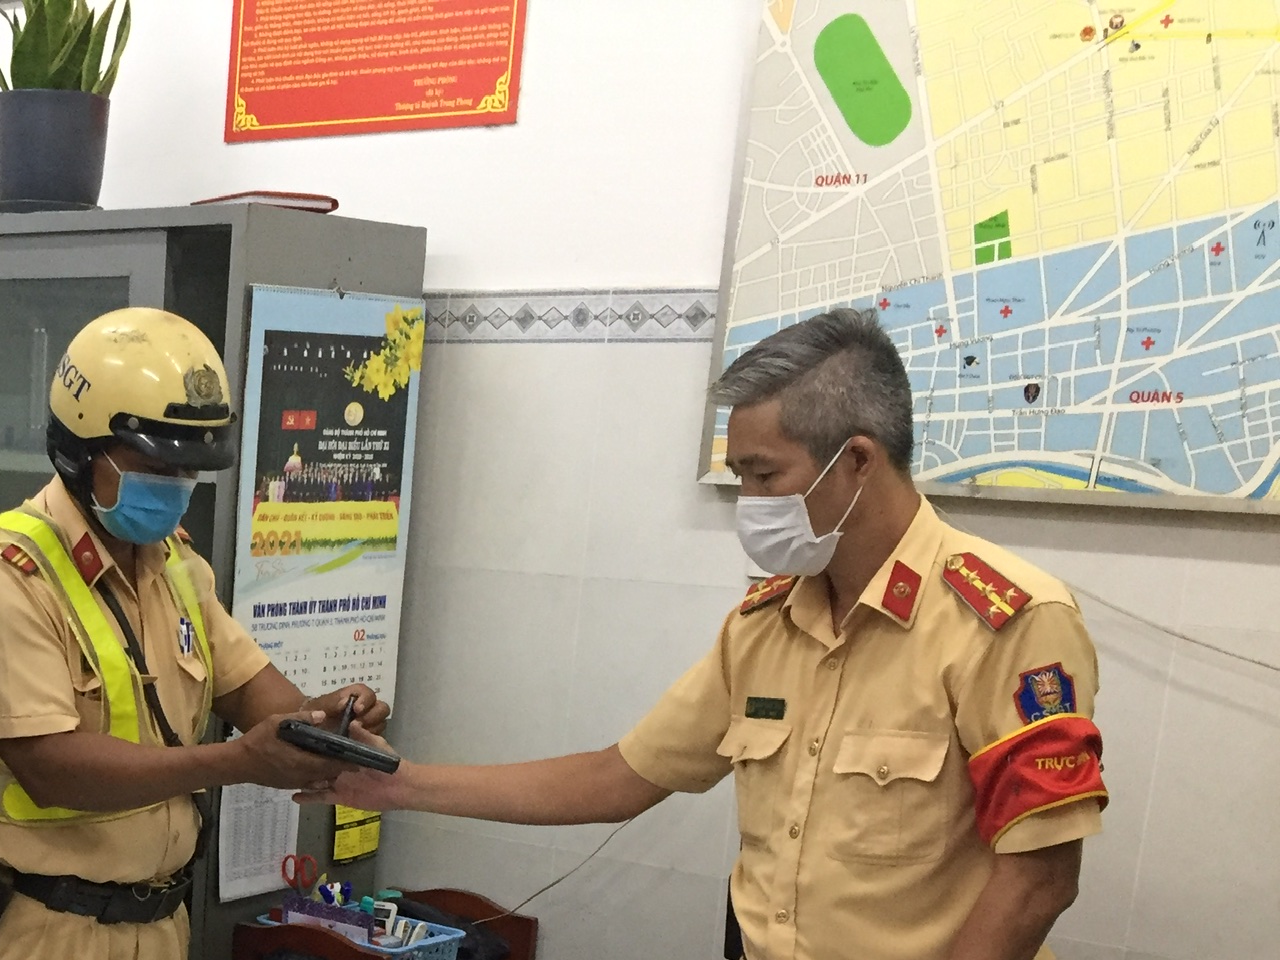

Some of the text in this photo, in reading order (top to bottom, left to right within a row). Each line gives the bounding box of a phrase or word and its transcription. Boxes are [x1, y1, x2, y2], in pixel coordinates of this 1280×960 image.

[815, 172, 868, 188] QUẬN 11
[1129, 389, 1184, 406] QUẬN 5
[252, 530, 302, 557] 2021
[353, 629, 366, 641] 02
